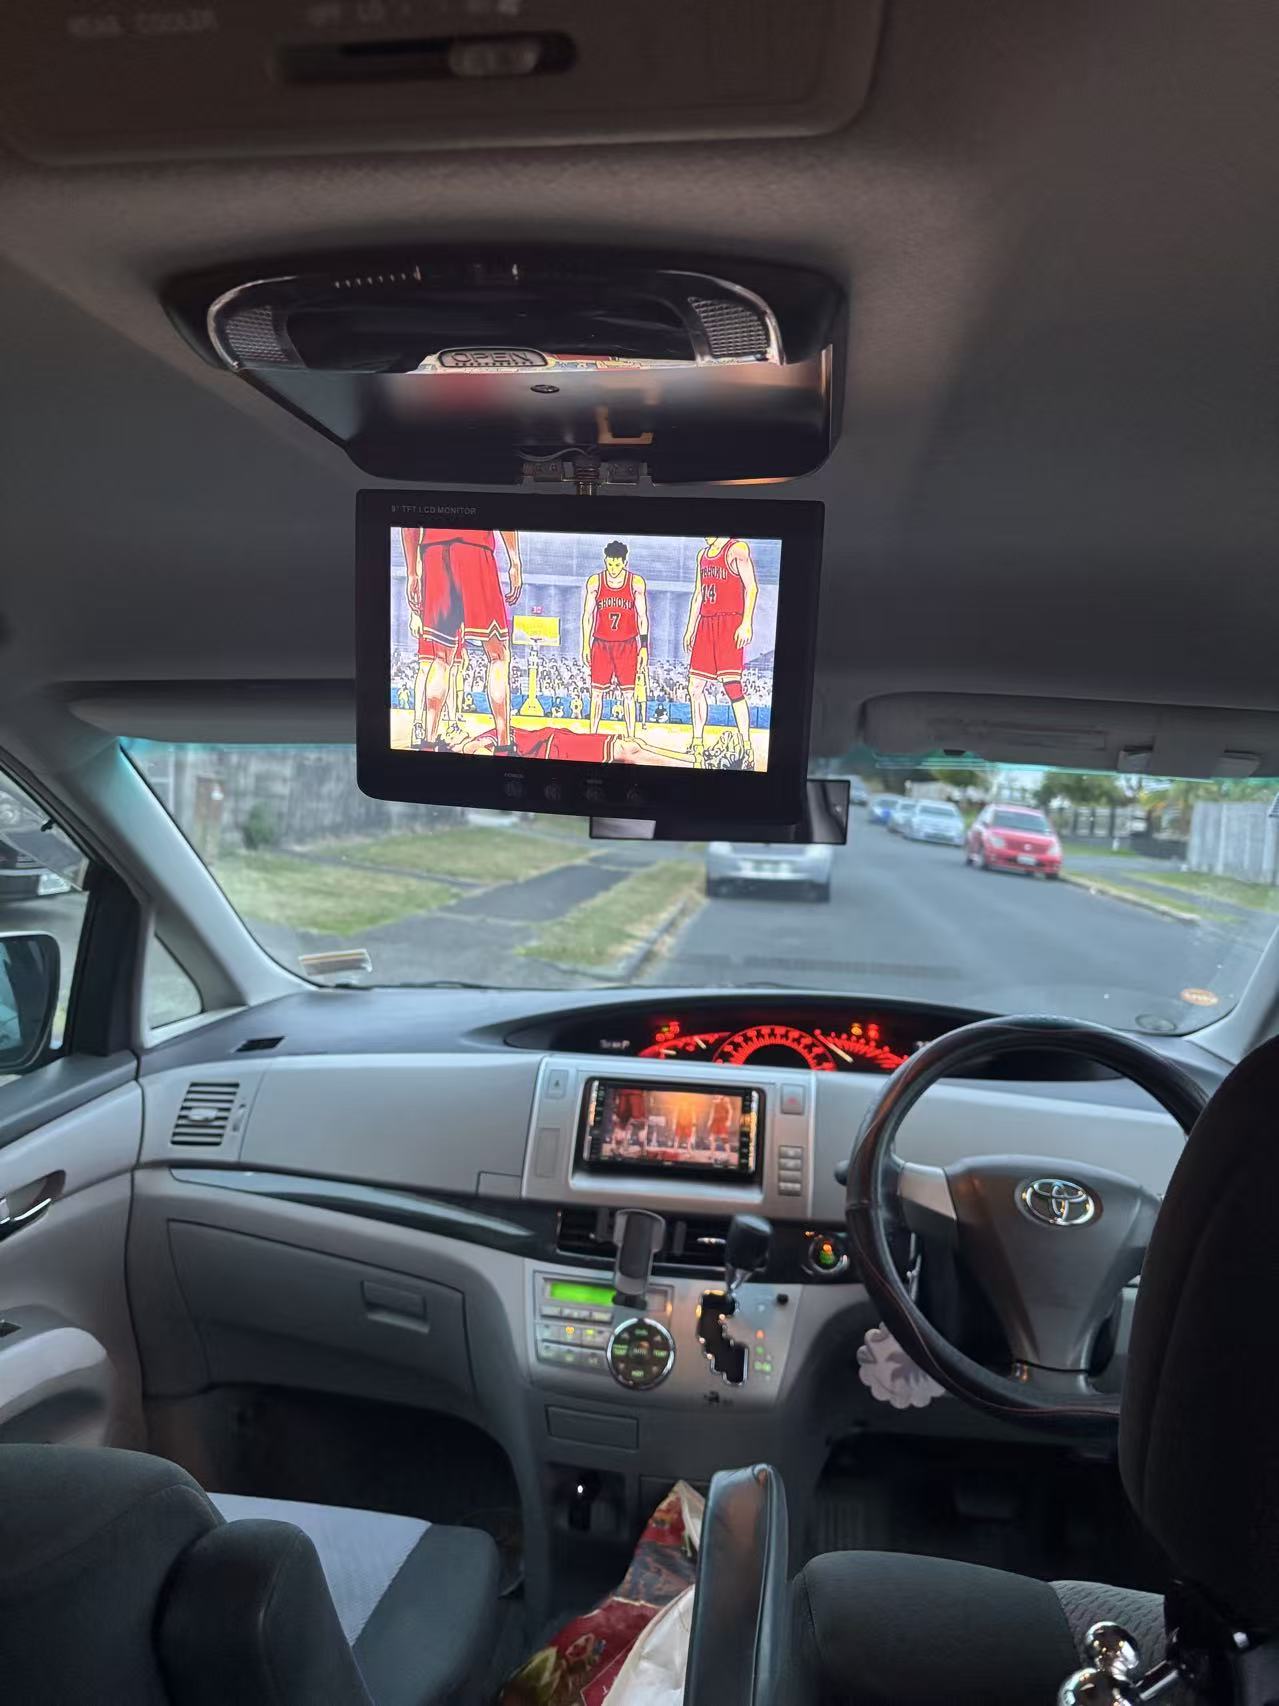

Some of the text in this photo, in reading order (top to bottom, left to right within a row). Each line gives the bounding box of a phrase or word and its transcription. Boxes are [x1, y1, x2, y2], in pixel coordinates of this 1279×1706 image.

[451, 351, 532, 363] OPEN
[418, 505, 435, 514] LCD
[437, 505, 477, 515] MONITOR
[609, 612, 621, 631] 7
